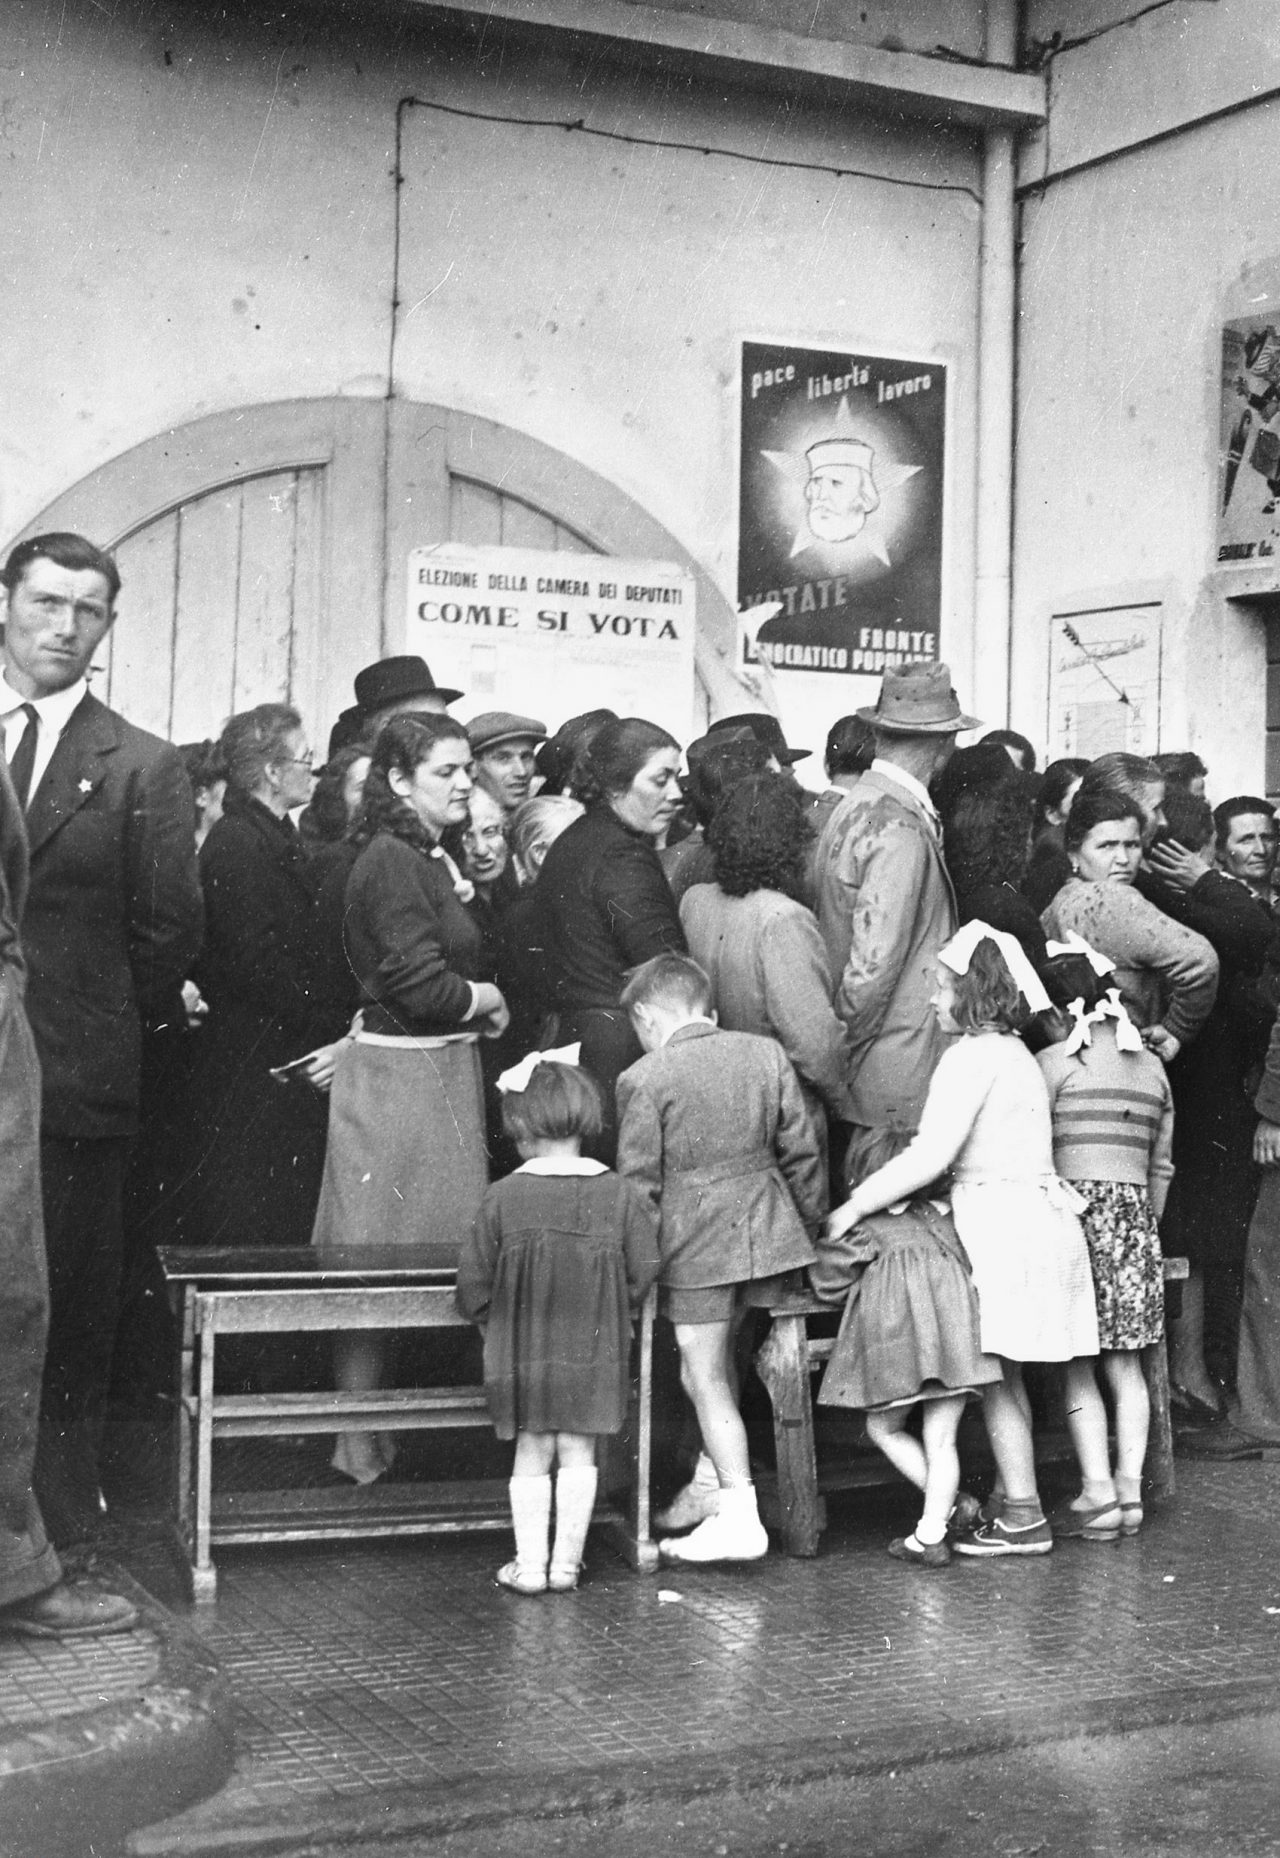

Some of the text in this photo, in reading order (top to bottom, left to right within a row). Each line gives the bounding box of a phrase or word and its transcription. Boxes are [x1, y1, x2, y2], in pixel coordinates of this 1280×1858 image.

[752, 364, 795, 398] pace
[878, 374, 932, 403] lavoro
[418, 568, 683, 605] ELEZIONE DELLA CAMERA DEI DEPUTATI
[418, 601, 680, 639] COME SI VOTA
[860, 628, 935, 653] FRONTE
